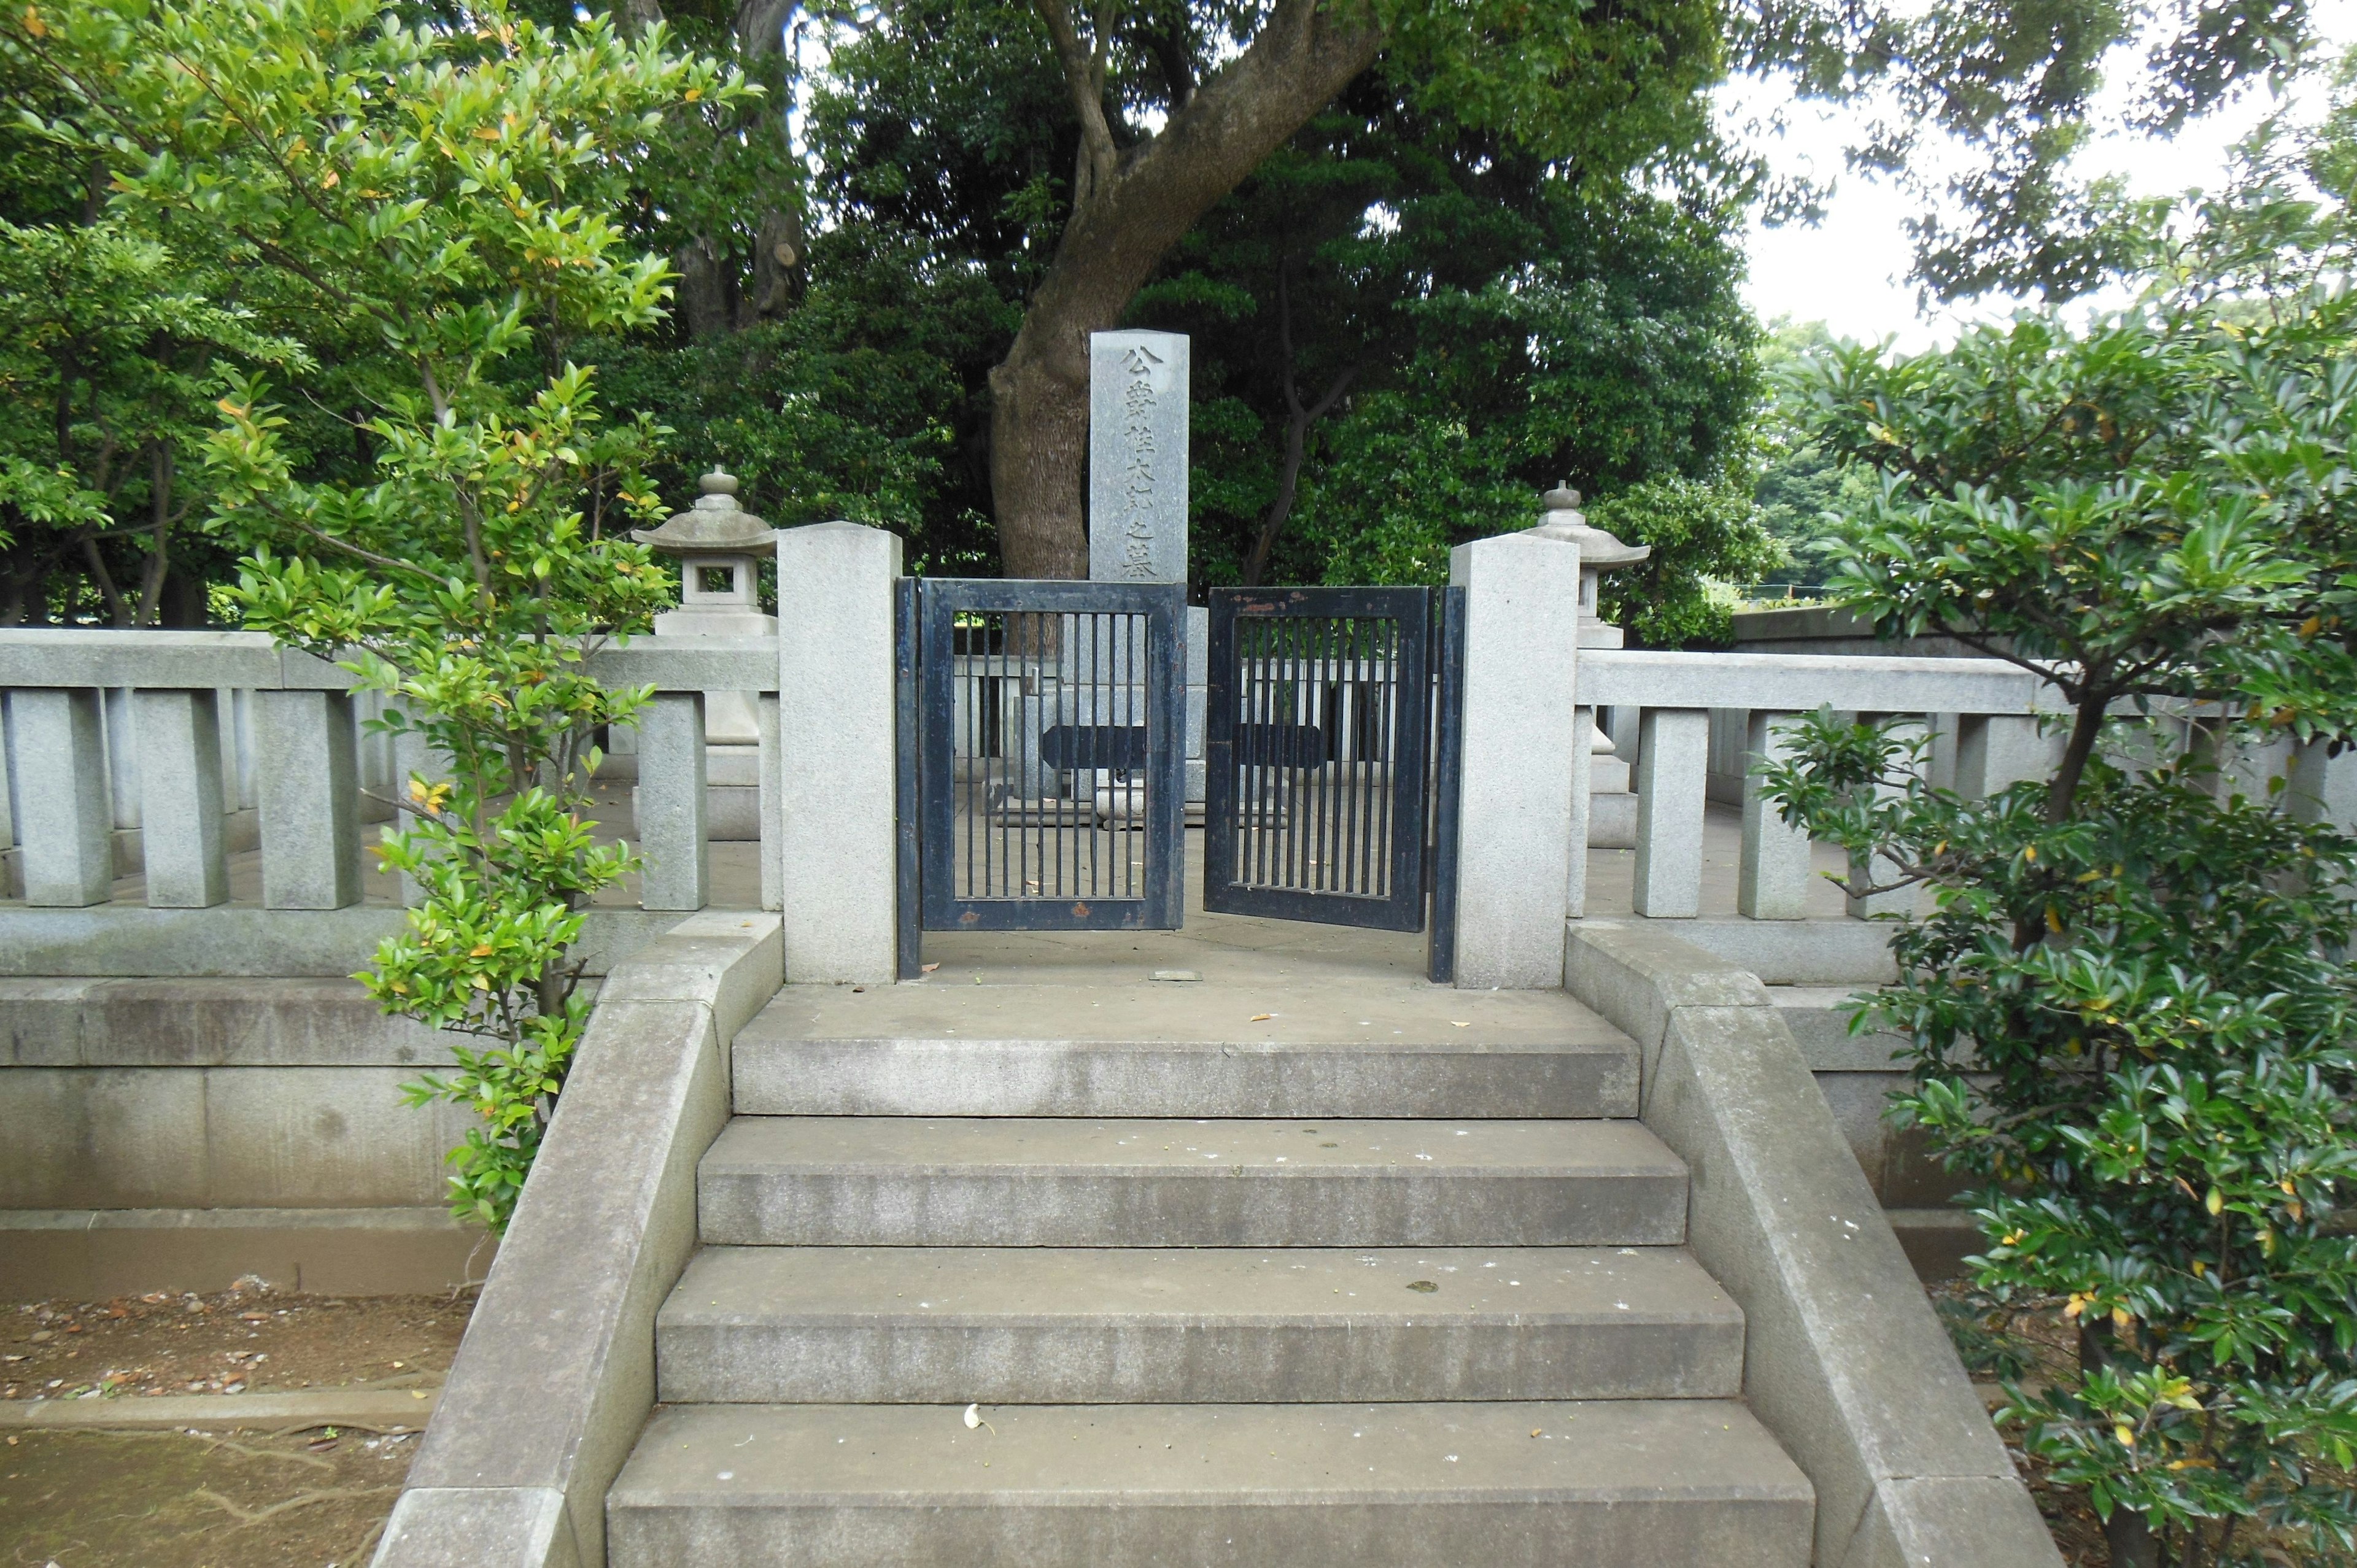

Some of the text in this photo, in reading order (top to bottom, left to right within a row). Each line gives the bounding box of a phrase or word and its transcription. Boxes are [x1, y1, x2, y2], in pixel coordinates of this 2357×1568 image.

[1120, 345, 1164, 577] 公爵桂太郎之墓
